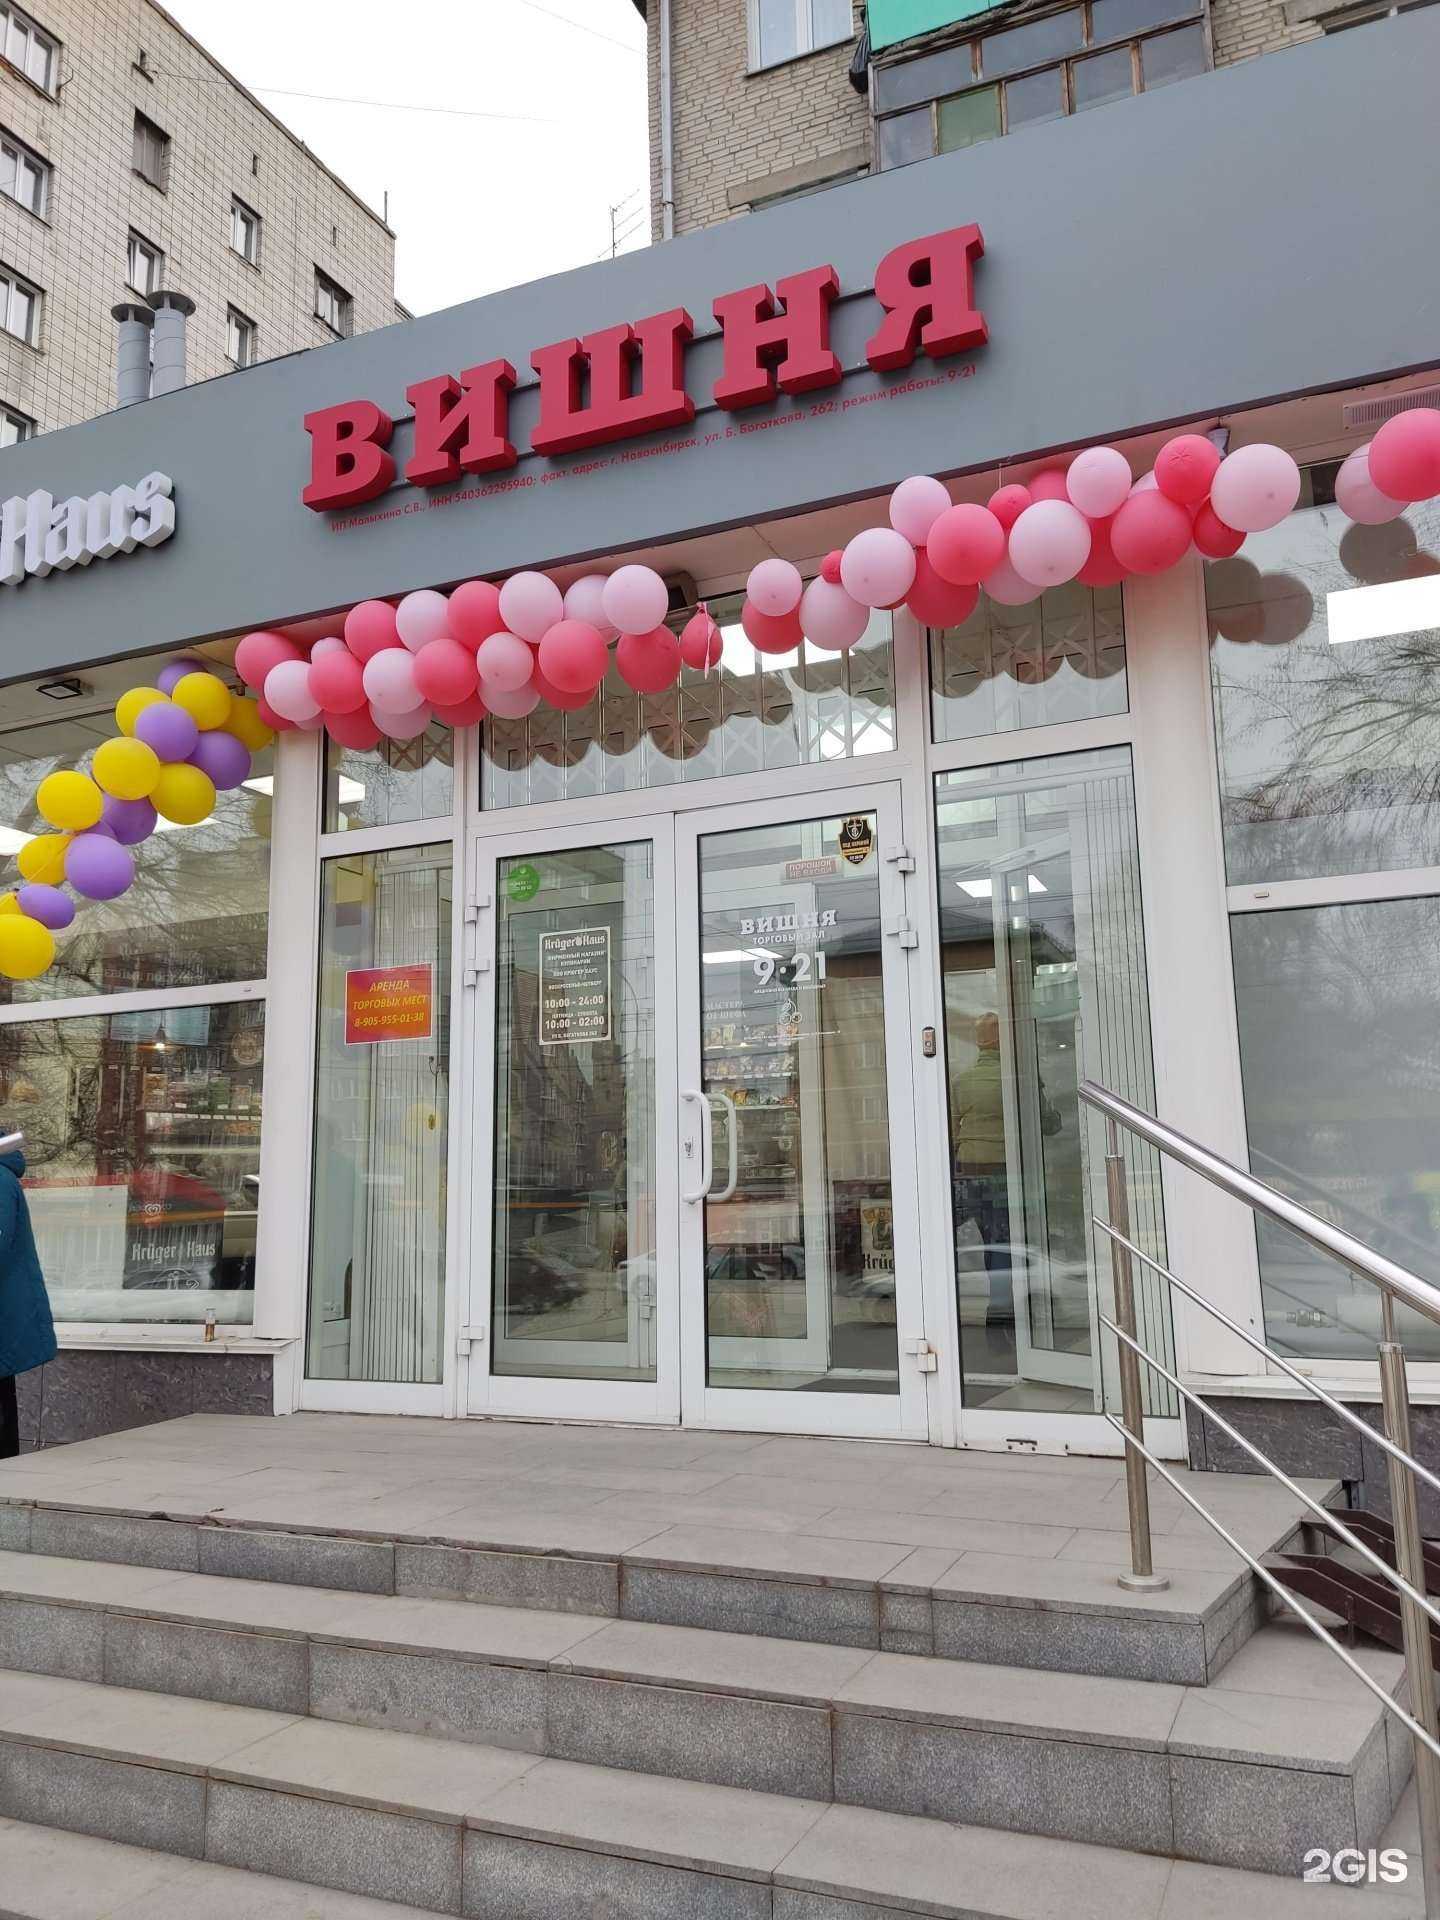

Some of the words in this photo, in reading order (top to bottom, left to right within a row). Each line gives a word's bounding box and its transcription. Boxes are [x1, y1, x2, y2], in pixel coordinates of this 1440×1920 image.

[302, 222, 988, 512] ВИШНЯ
[331, 519, 346, 533] ИП
[428, 494, 452, 510] ИНН
[540, 468, 569, 485] факт.
[621, 436, 700, 464] Новосибирск,
[704, 431, 722, 445] ул.
[842, 389, 886, 410] режим
[889, 374, 944, 401] работы:
[947, 364, 977, 383] 9-21
[740, 909, 838, 935] ВИШНЯ
[583, 935, 605, 946] Haus
[369, 979, 410, 993] АРЕНДА
[353, 998, 400, 1010] ТОРГОВЫХ
[403, 994, 427, 1006] МЕСТ
[545, 997, 570, 1009] 10:00
[578, 995, 604, 1005] 24:00
[353, 1012, 425, 1027] 8-905-955-01-38
[545, 1018, 570, 1030] 10:00
[578, 1015, 604, 1026] 02:00
[131, 1243, 176, 1264] Krüger
[186, 1240, 216, 1257] Haus
